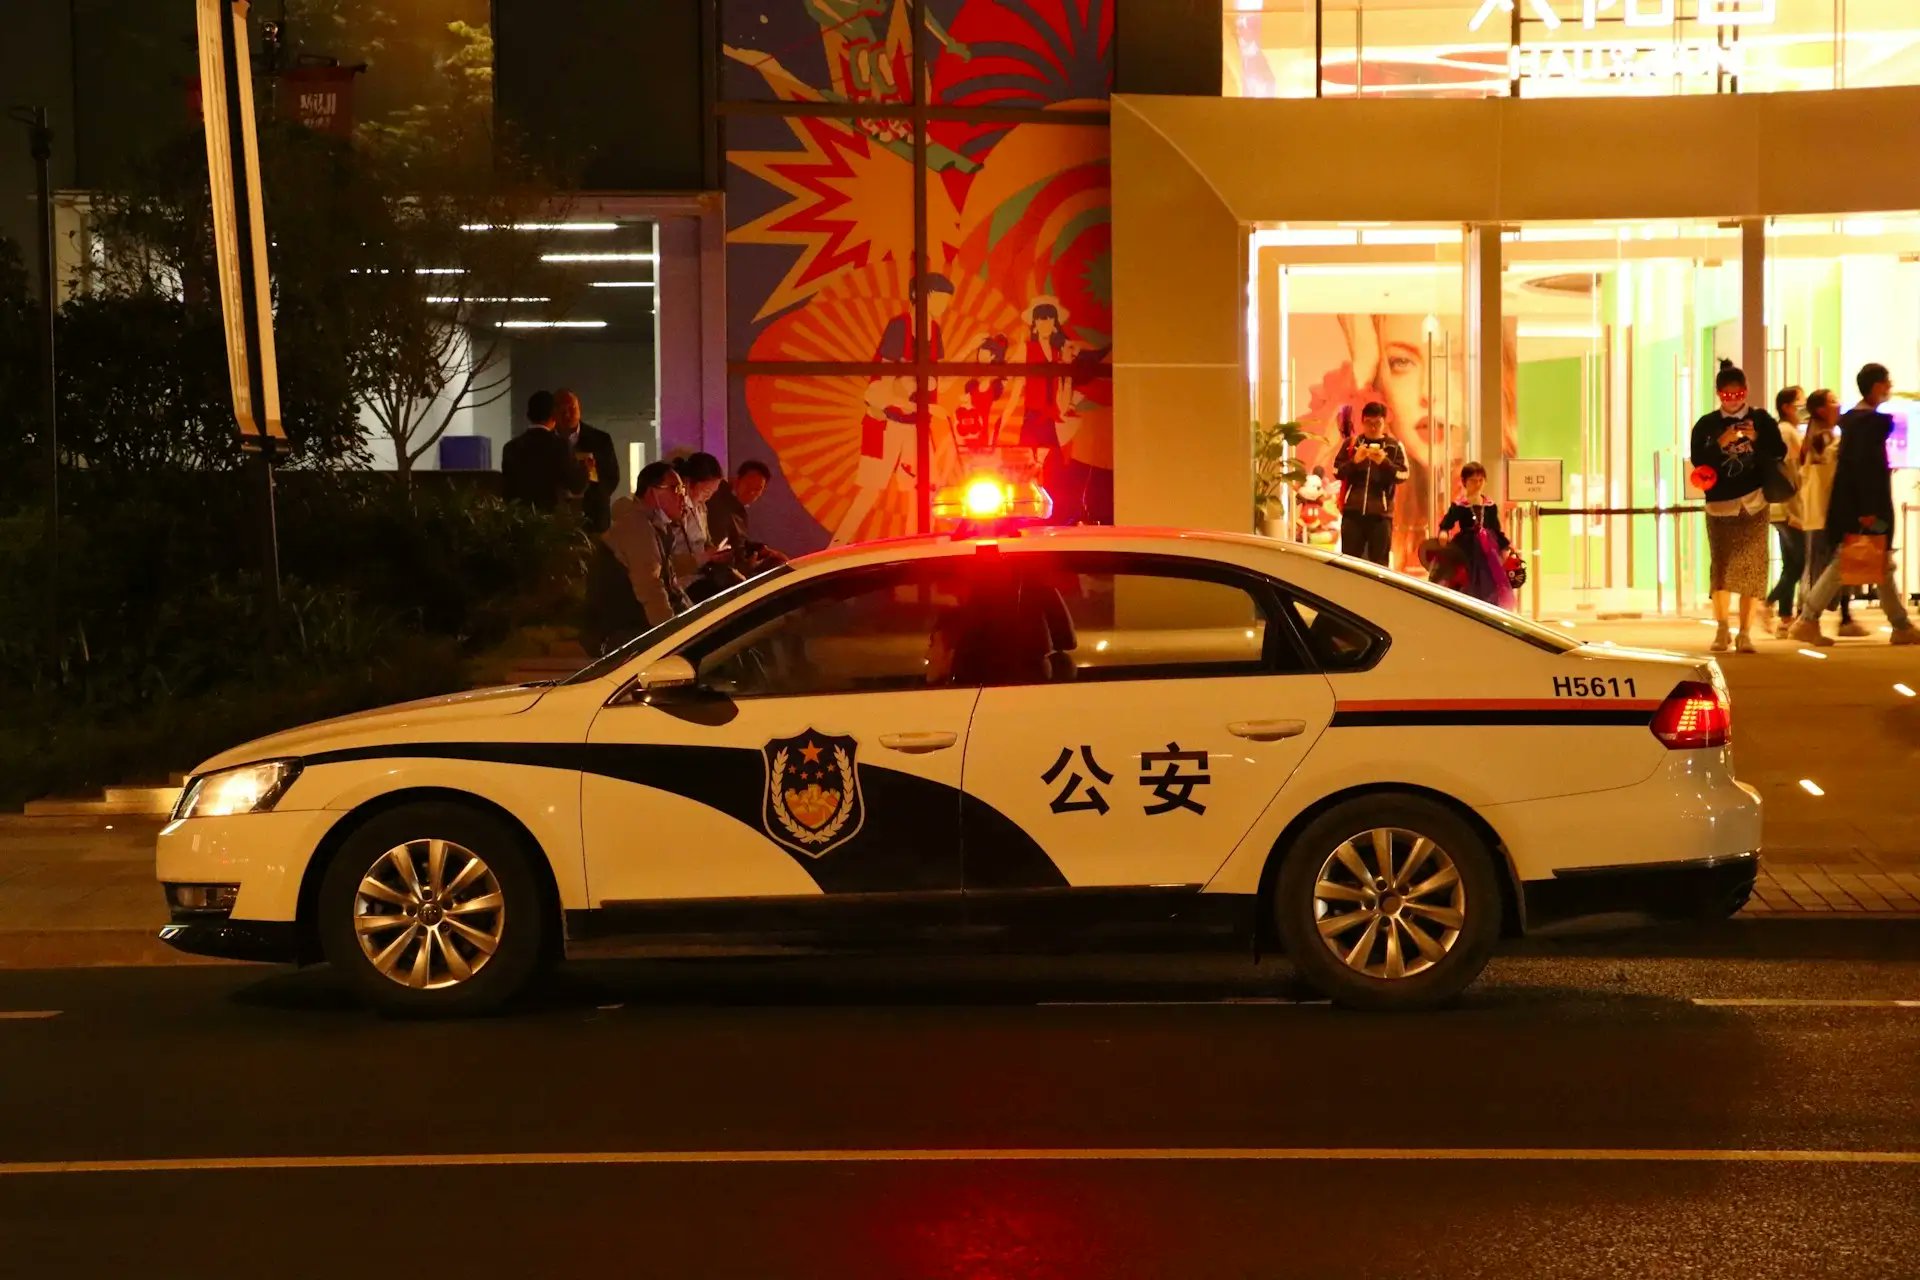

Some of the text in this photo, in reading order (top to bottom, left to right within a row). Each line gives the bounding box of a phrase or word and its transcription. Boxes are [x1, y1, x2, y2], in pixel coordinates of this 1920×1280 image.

[1524, 475, 1545, 484] 出口
[1552, 676, 1636, 698] H5611
[1040, 741, 1211, 816] 公安
